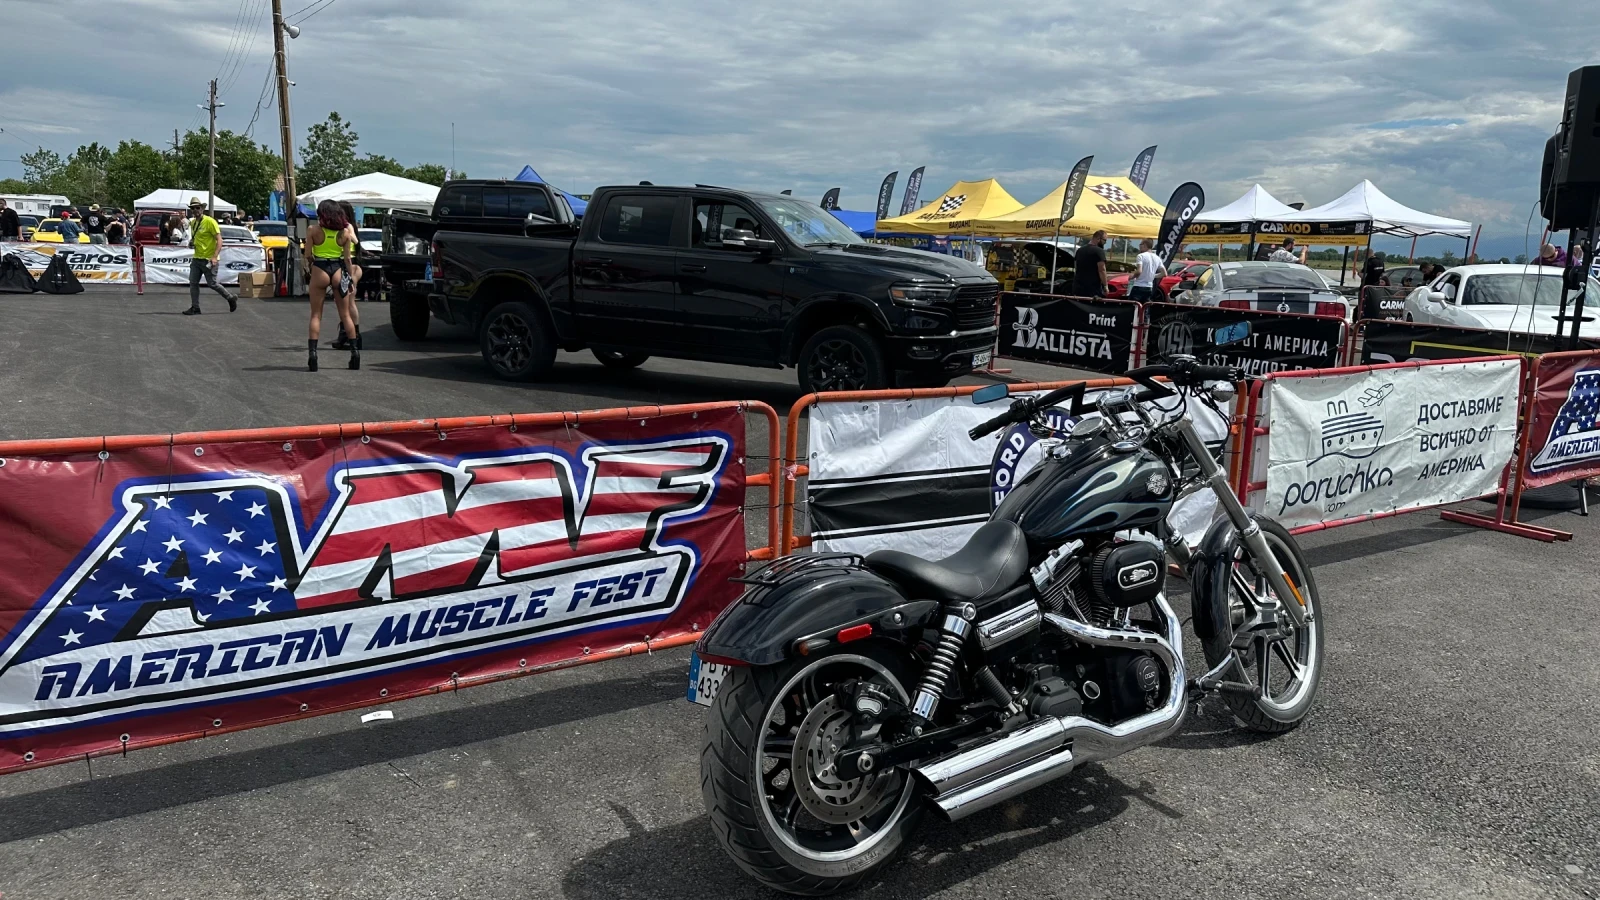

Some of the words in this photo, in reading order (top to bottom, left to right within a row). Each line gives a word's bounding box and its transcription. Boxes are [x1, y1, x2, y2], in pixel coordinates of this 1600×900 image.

[1062, 171, 1079, 220] PLASMA
[948, 220, 971, 230] BARDAHL
[1026, 219, 1055, 230] BARDAHL
[1095, 204, 1162, 220] BARDAHL
[1159, 196, 1199, 261] CARMOD
[1260, 222, 1312, 234] CARMOD
[58, 250, 128, 265] Taros
[1012, 306, 1112, 360] BALLISTA
[1089, 313, 1116, 327] Print
[1264, 334, 1328, 357] АМЕРИКА
[1418, 396, 1504, 425] ДОСТАВЯМЕ
[1420, 430, 1476, 453] ВСИЧКО
[1478, 425, 1496, 442] ОТ
[994, 432, 1026, 507] FORD
[1418, 454, 1486, 481] АМЕРИКА
[34, 622, 353, 701] AMERICAN
[364, 587, 555, 651] MUSCLE
[566, 566, 667, 613] FEST
